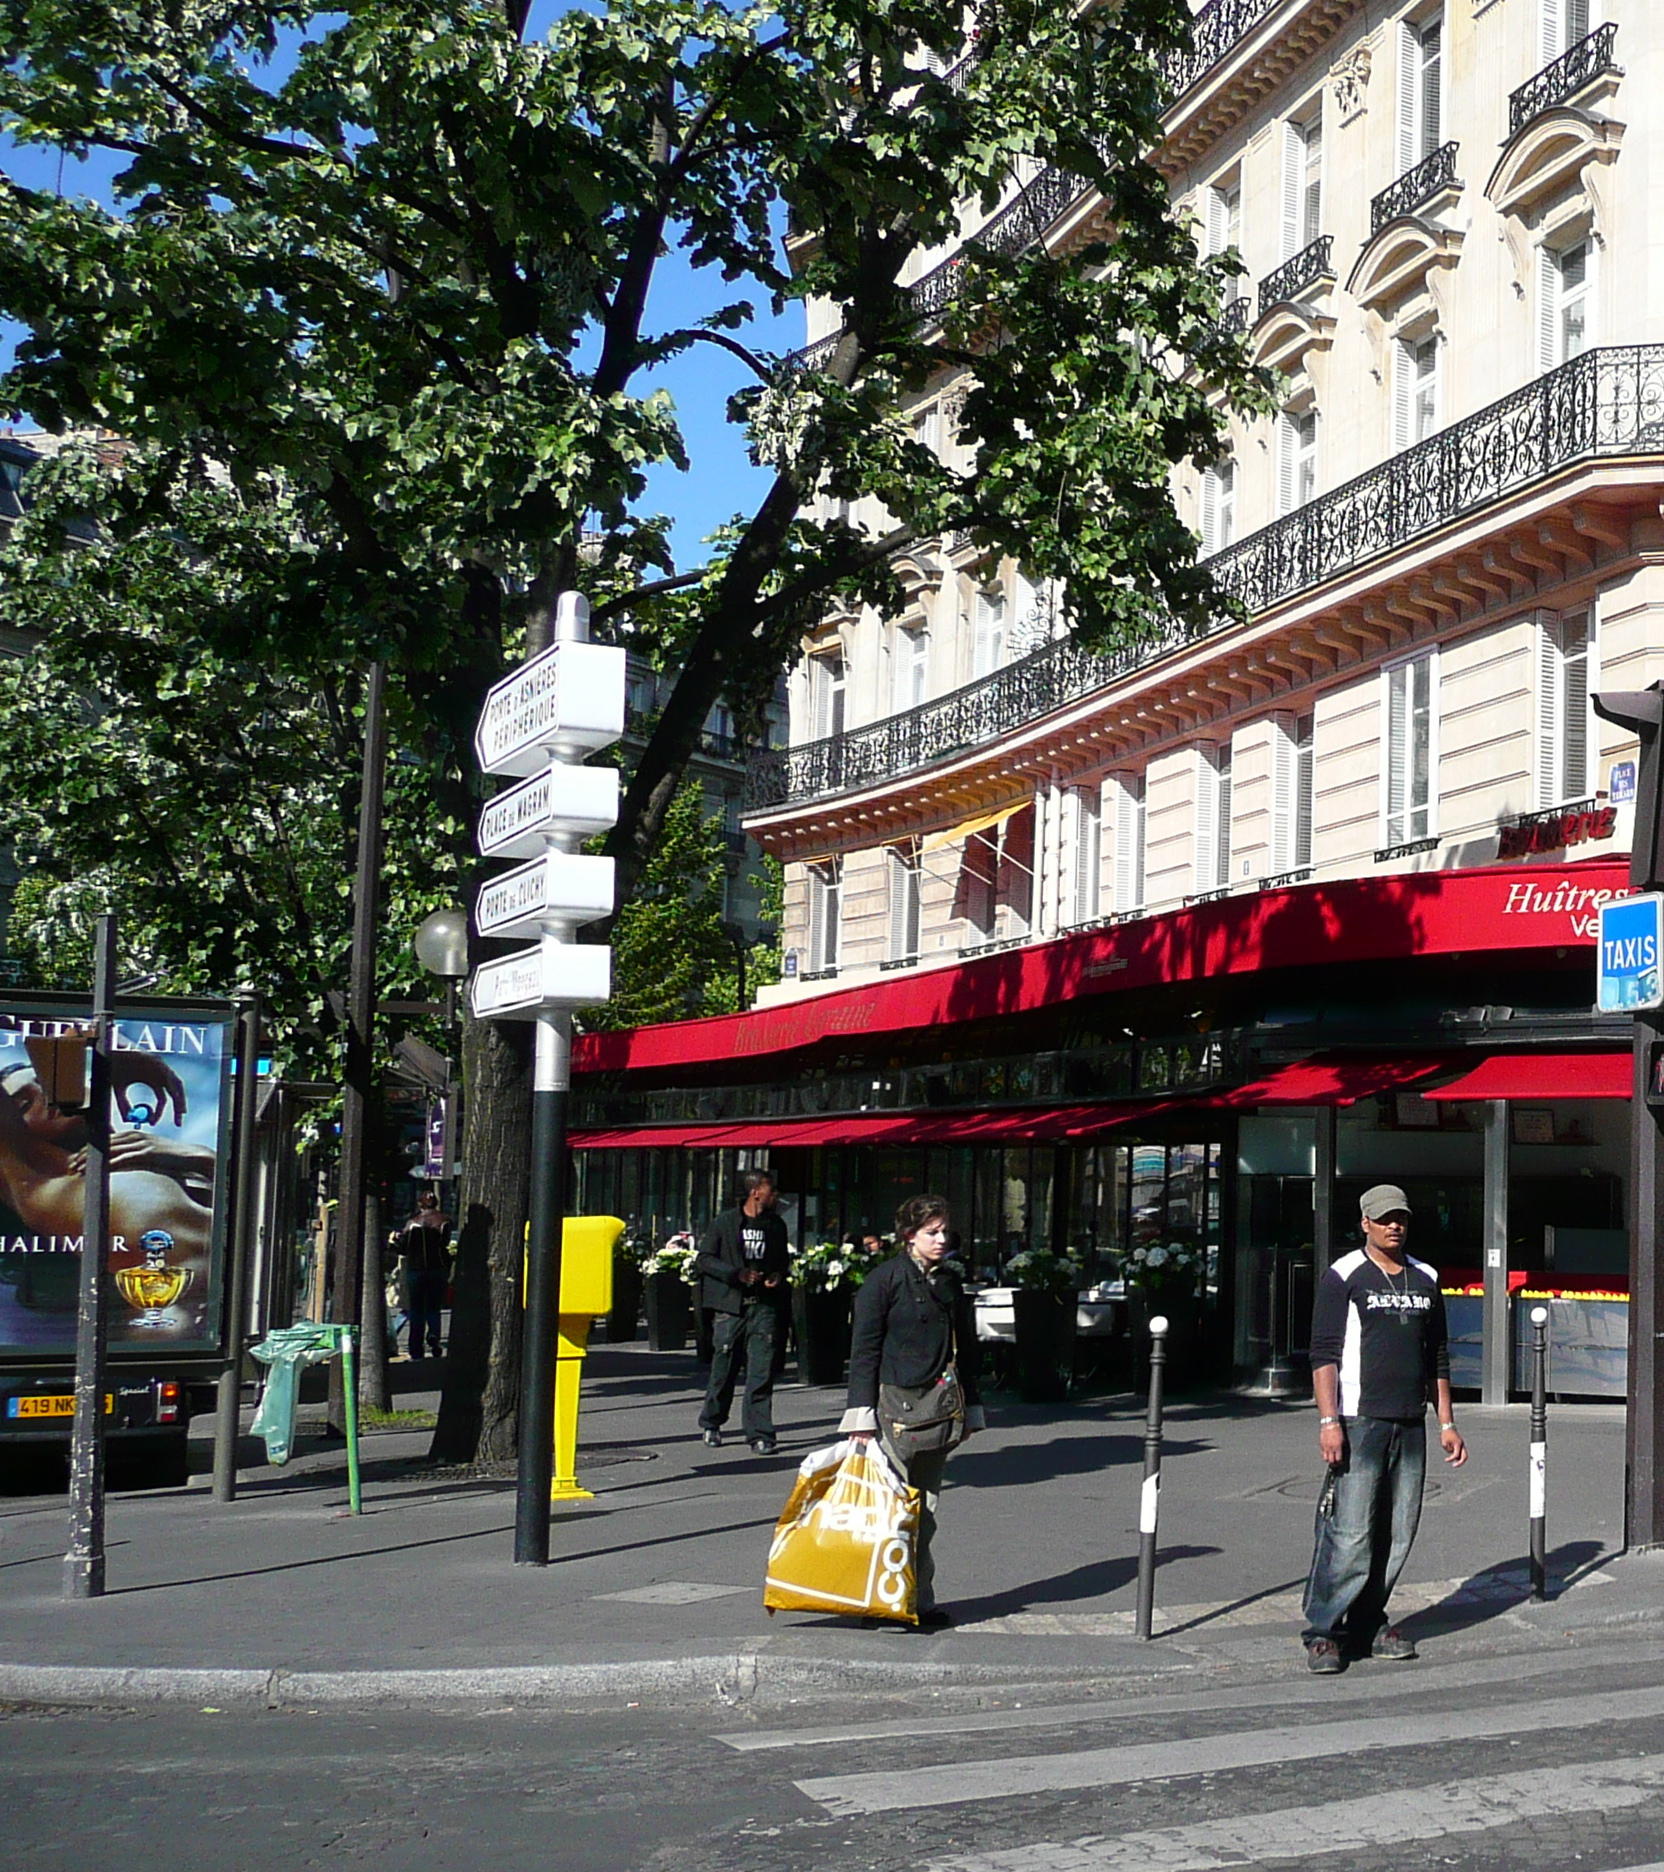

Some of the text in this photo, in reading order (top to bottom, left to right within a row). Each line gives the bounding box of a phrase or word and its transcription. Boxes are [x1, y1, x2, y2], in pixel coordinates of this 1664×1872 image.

[490, 692, 512, 726] PORTE
[493, 694, 556, 752] PÉRIPHÉRIQUE
[486, 808, 507, 841] PLACE
[517, 782, 550, 823] WAGRAM
[486, 890, 507, 920] PORTE
[518, 872, 545, 907] CLICHY
[1604, 935, 1656, 970] TAXIS
[0, 1015, 208, 1055] GUELAIN
[0, 1235, 129, 1253] HALIMR
[20, 1395, 76, 1413] 419 NK
